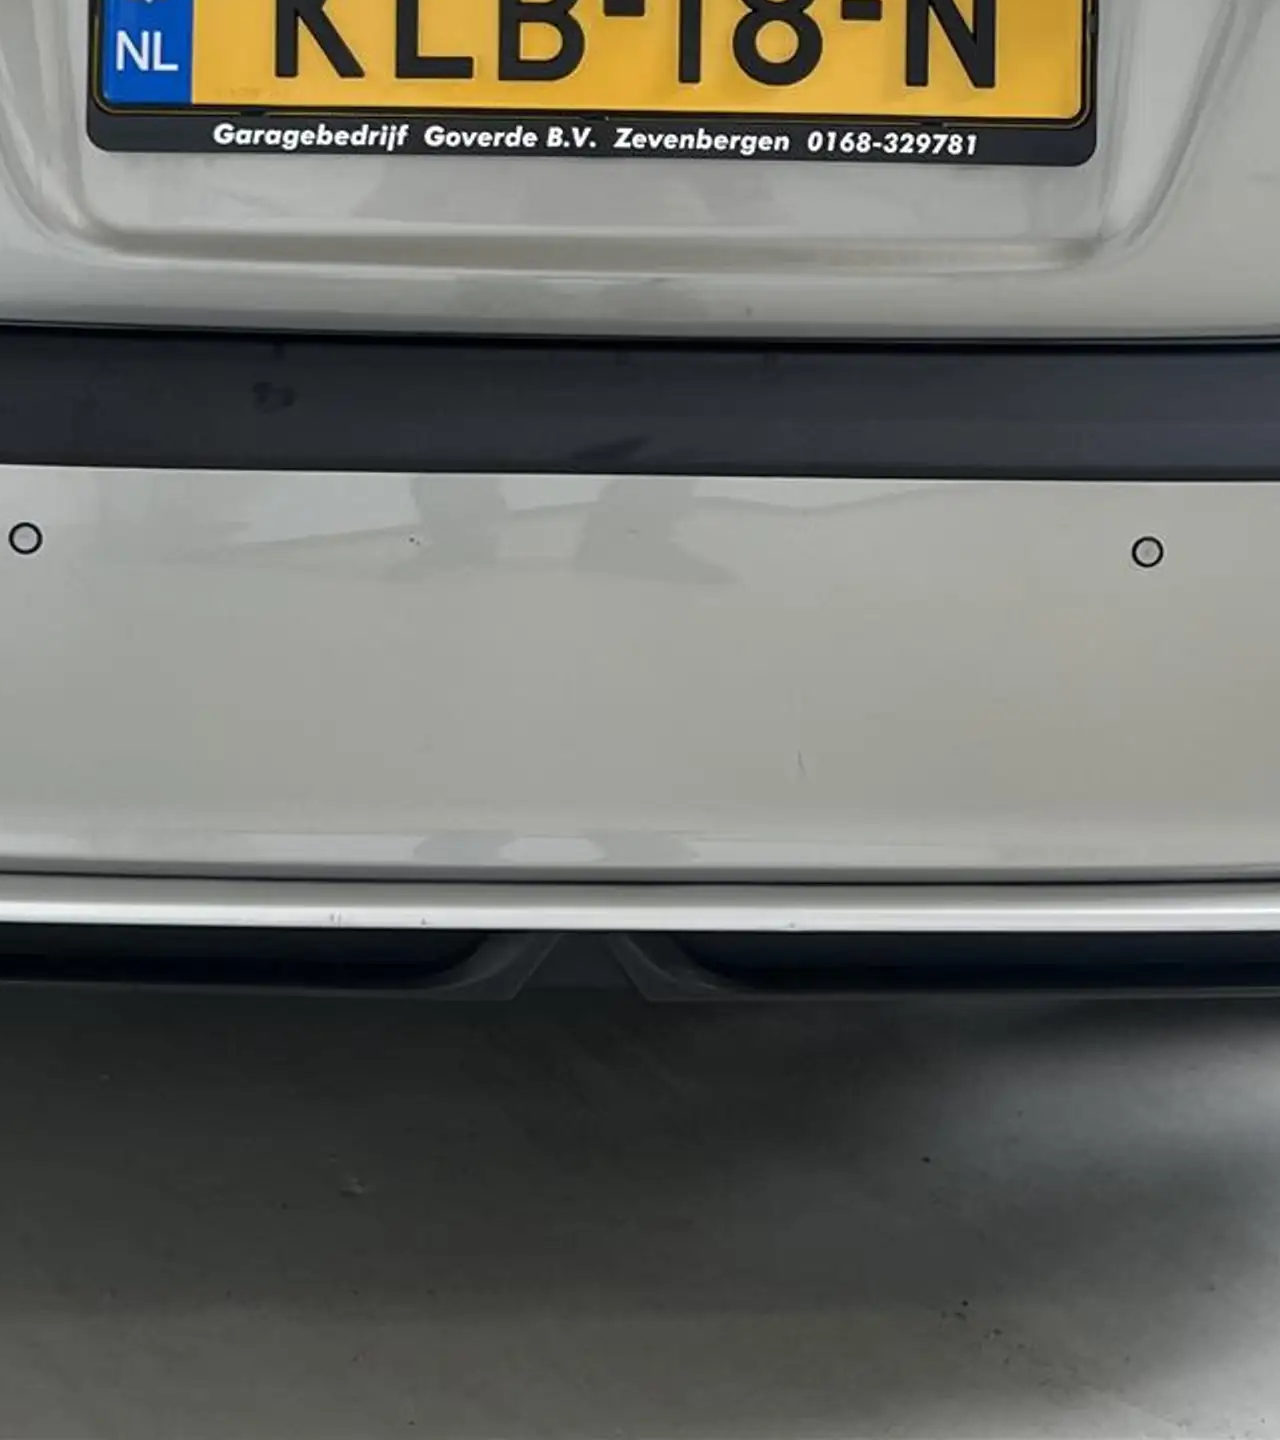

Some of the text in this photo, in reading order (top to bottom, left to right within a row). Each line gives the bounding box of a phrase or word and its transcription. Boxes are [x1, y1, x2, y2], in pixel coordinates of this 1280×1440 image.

[116, 30, 179, 71] NL
[213, 123, 977, 156] Garagebedrijf Goverde B.V. Zevenbergen 0168-329781
